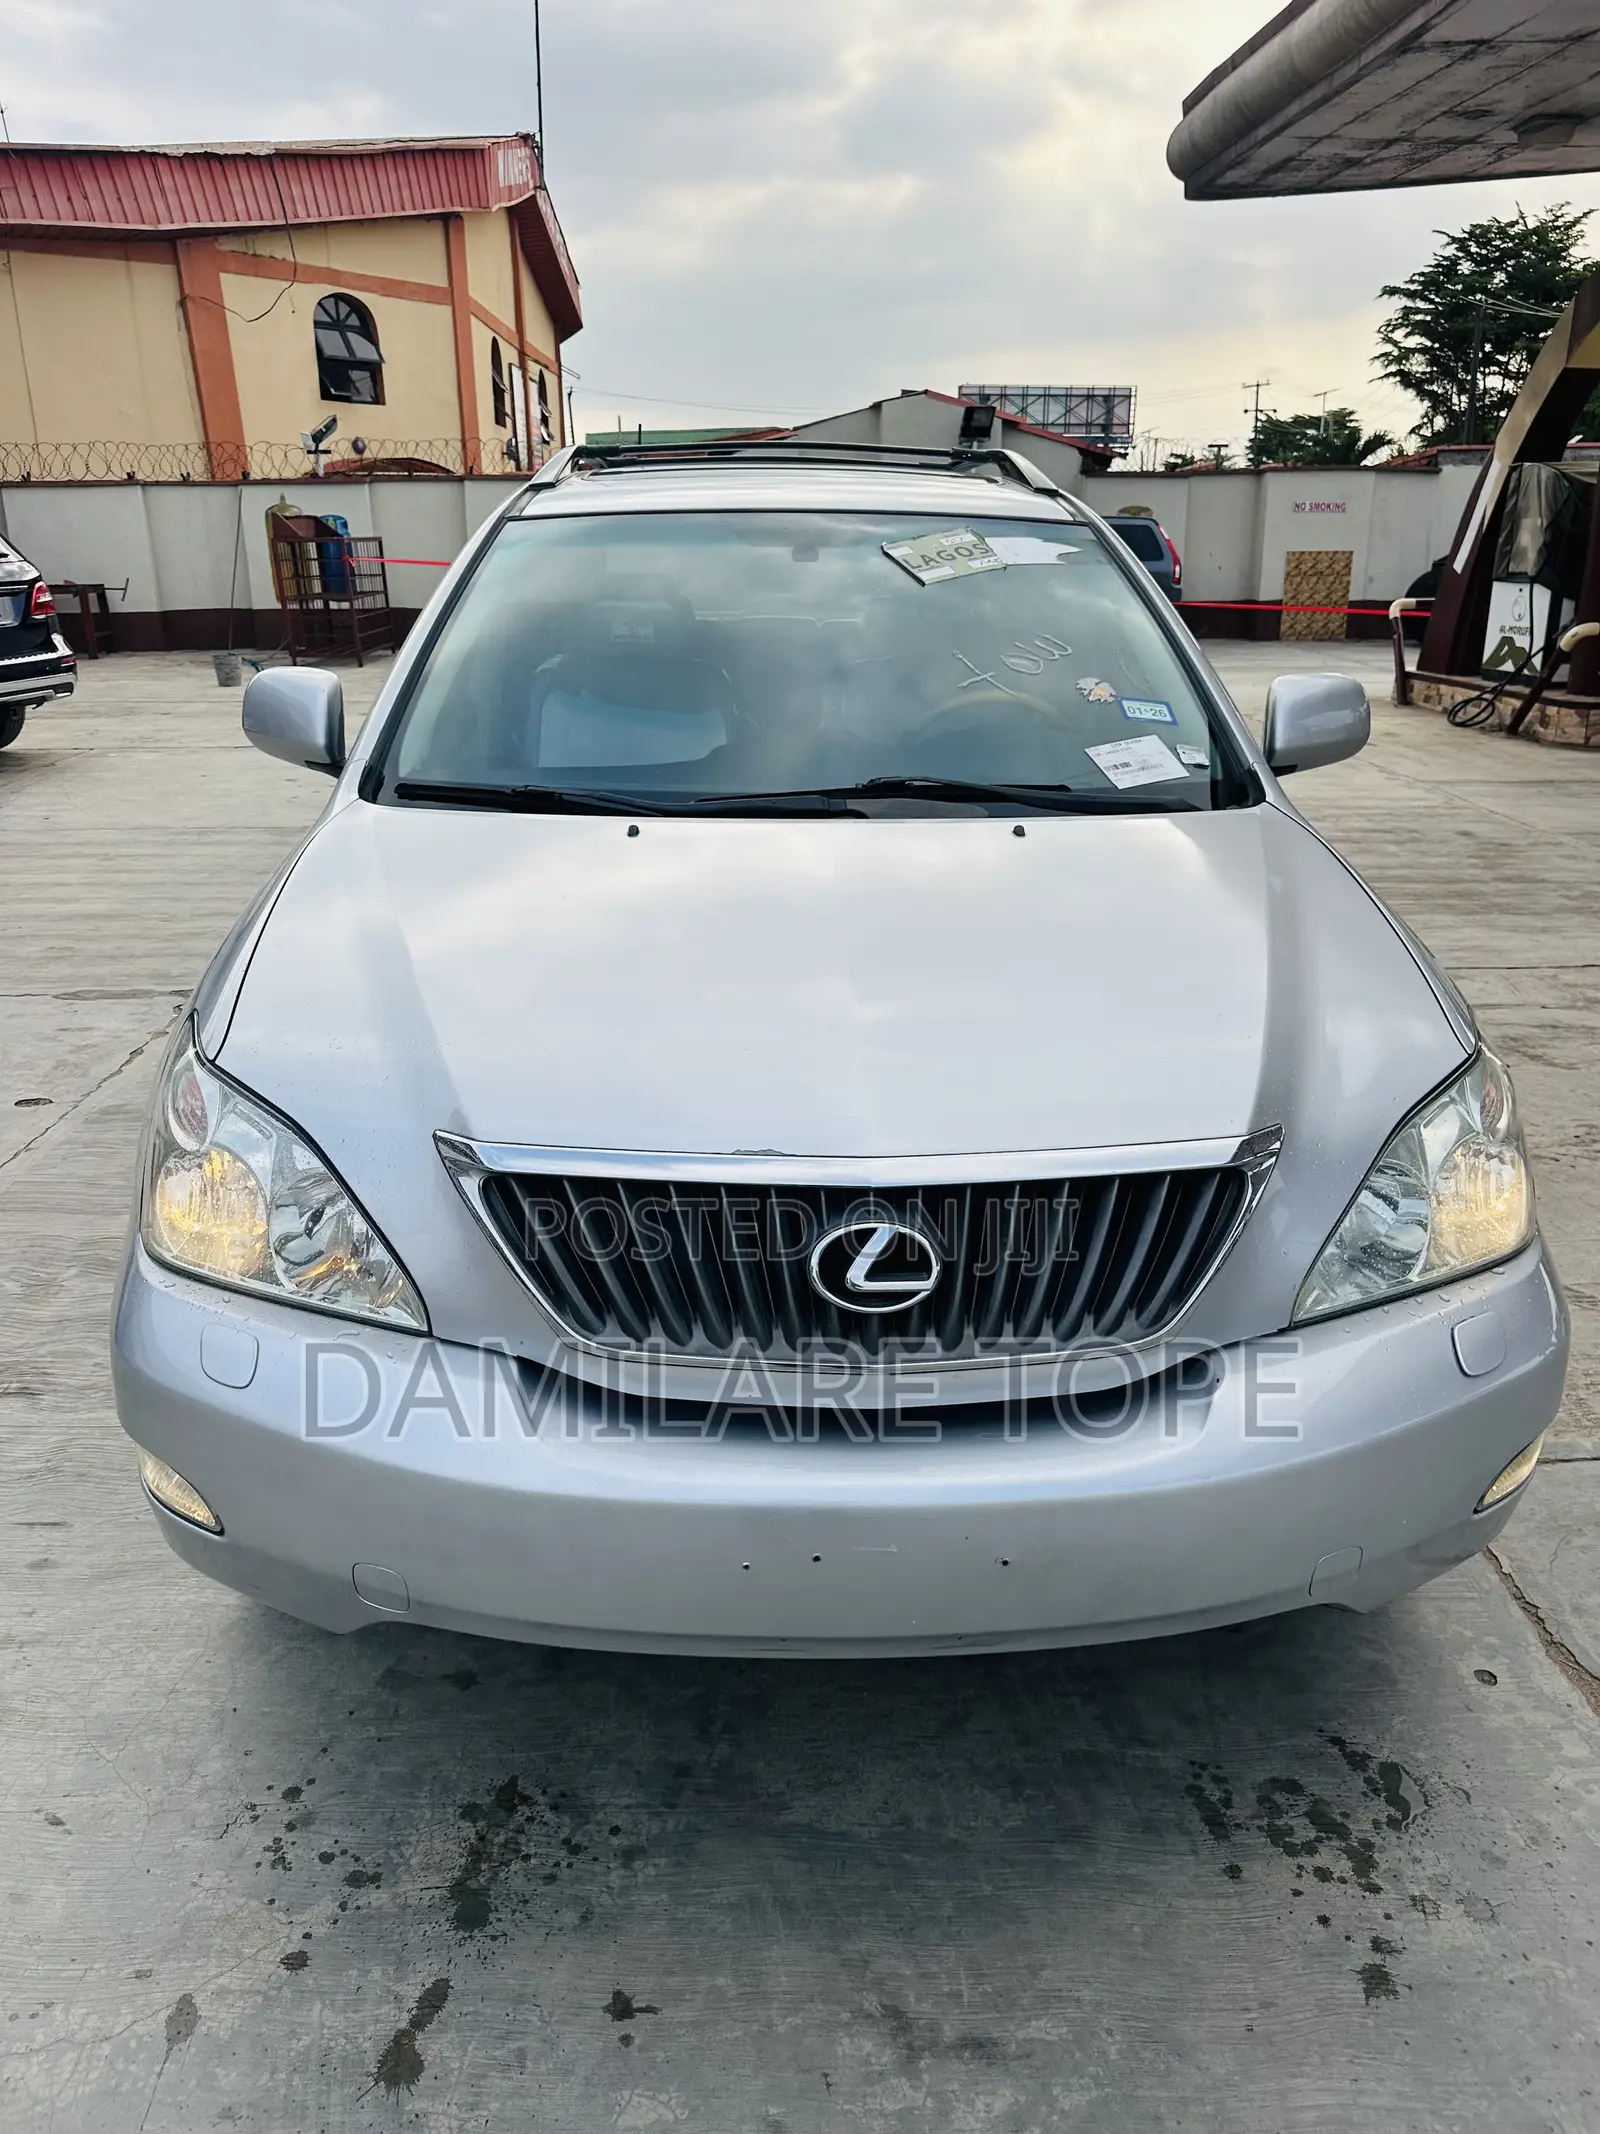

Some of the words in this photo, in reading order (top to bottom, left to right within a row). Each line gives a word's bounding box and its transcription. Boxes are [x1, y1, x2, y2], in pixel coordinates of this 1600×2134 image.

[1294, 501, 1306, 512] NO
[1309, 501, 1347, 512] SMOKING
[902, 542, 990, 569] LAGOS
